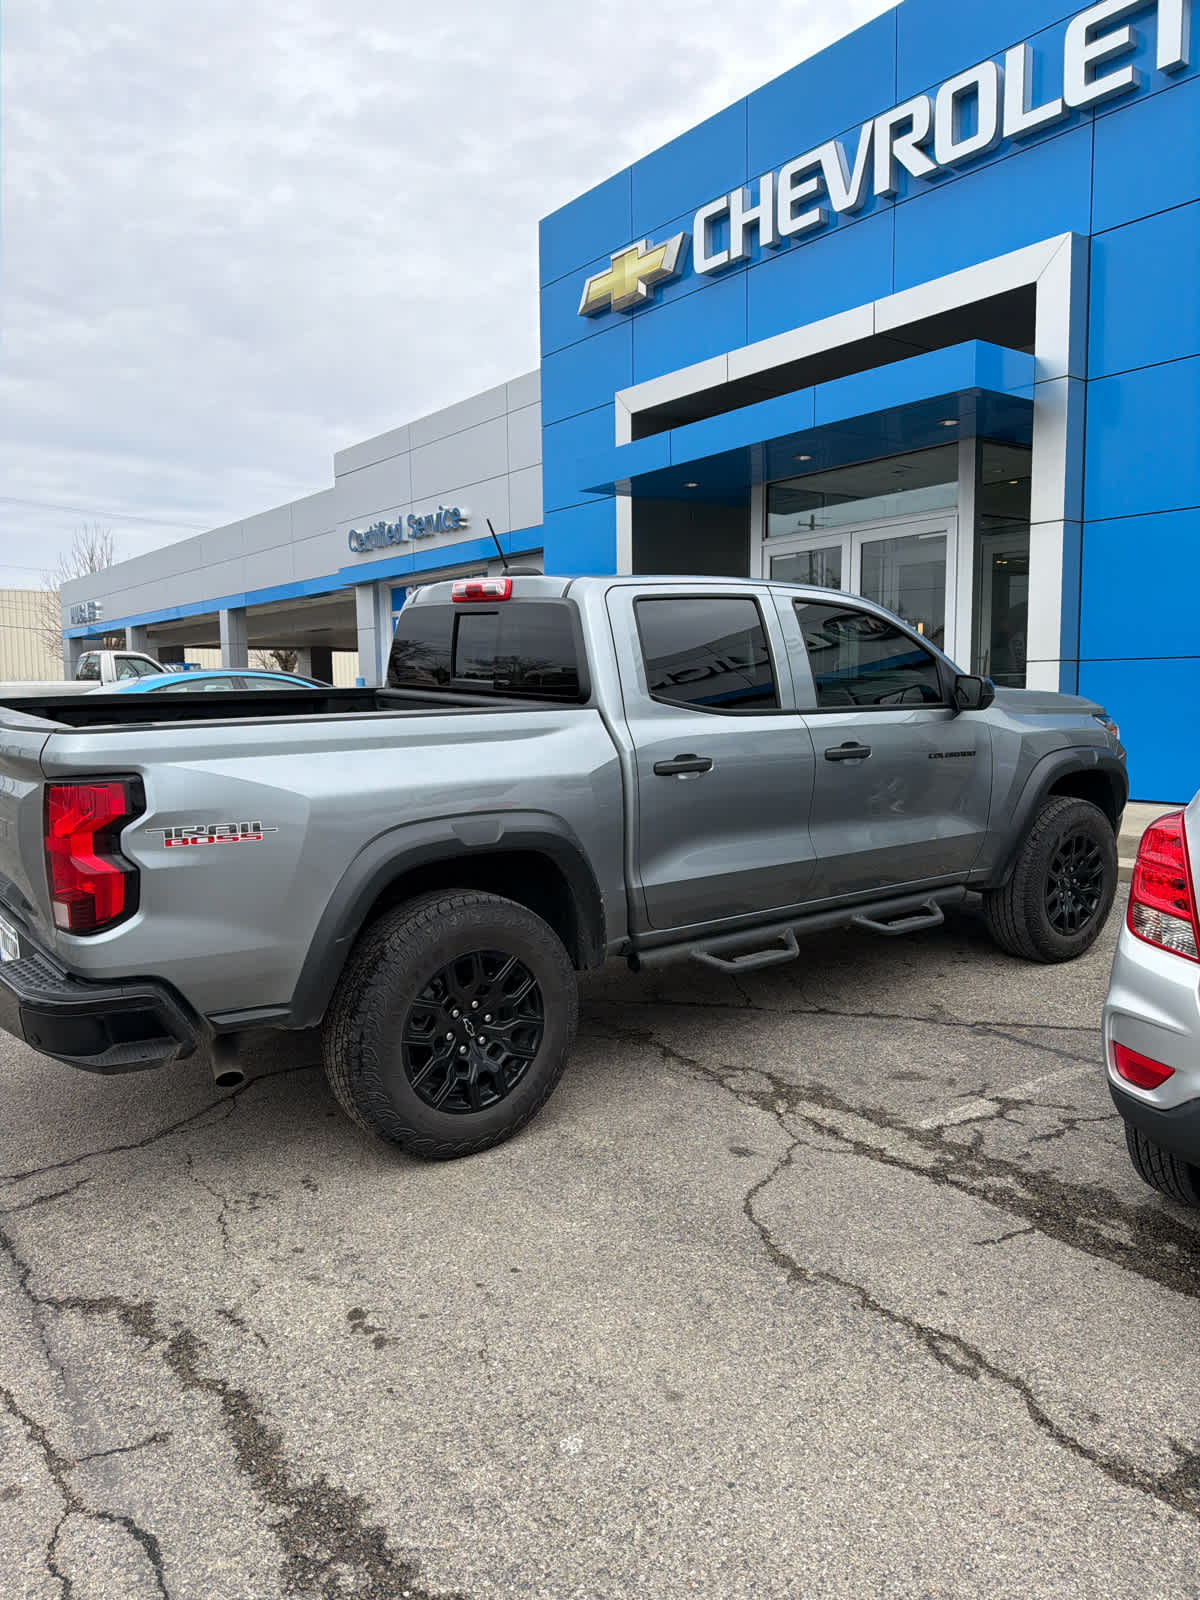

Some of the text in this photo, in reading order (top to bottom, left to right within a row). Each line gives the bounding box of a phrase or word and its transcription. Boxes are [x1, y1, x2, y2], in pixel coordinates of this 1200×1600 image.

[348, 506, 463, 552] Certified Service
[145, 821, 279, 839] TRAIL
[164, 832, 263, 848] BOSS
